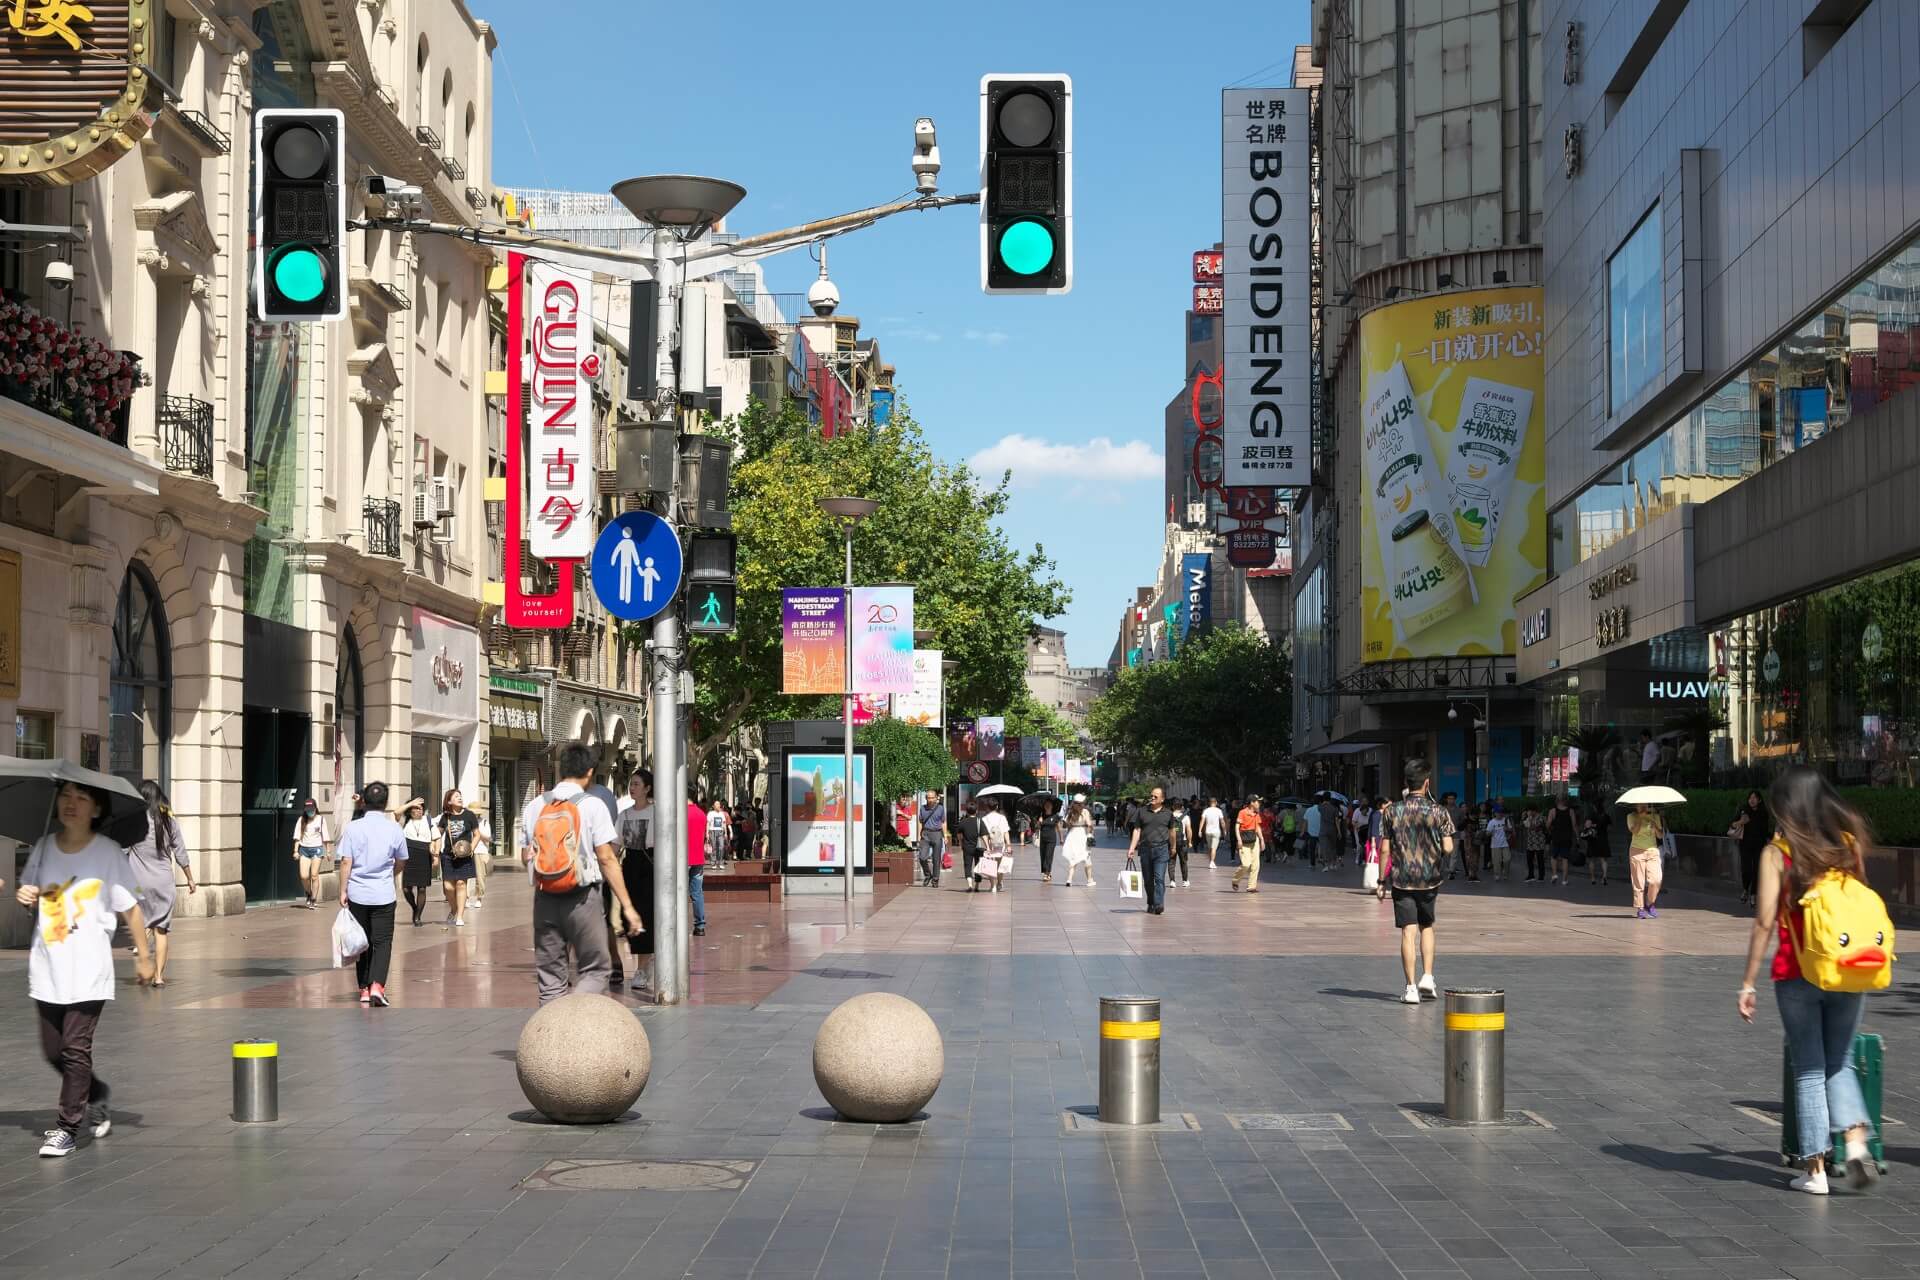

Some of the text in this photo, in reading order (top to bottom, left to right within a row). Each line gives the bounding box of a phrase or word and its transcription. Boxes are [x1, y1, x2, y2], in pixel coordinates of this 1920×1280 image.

[1246, 100, 1286, 119] 世界
[1246, 124, 1286, 143] 名牌
[1249, 150, 1283, 438] BOSIDENG
[533, 279, 579, 433] GUJIN
[1408, 331, 1542, 364] 一口就开心！
[1473, 402, 1517, 426] 香蕉味
[1462, 418, 1518, 446] 牛奶饮料
[1242, 446, 1293, 459] 波司登
[539, 447, 584, 538] 古今
[1240, 520, 1262, 529] VIP
[522, 599, 542, 607] love
[522, 608, 563, 617] yourself
[1649, 682, 1729, 699] HUAW
[254, 788, 297, 808] NIKE
